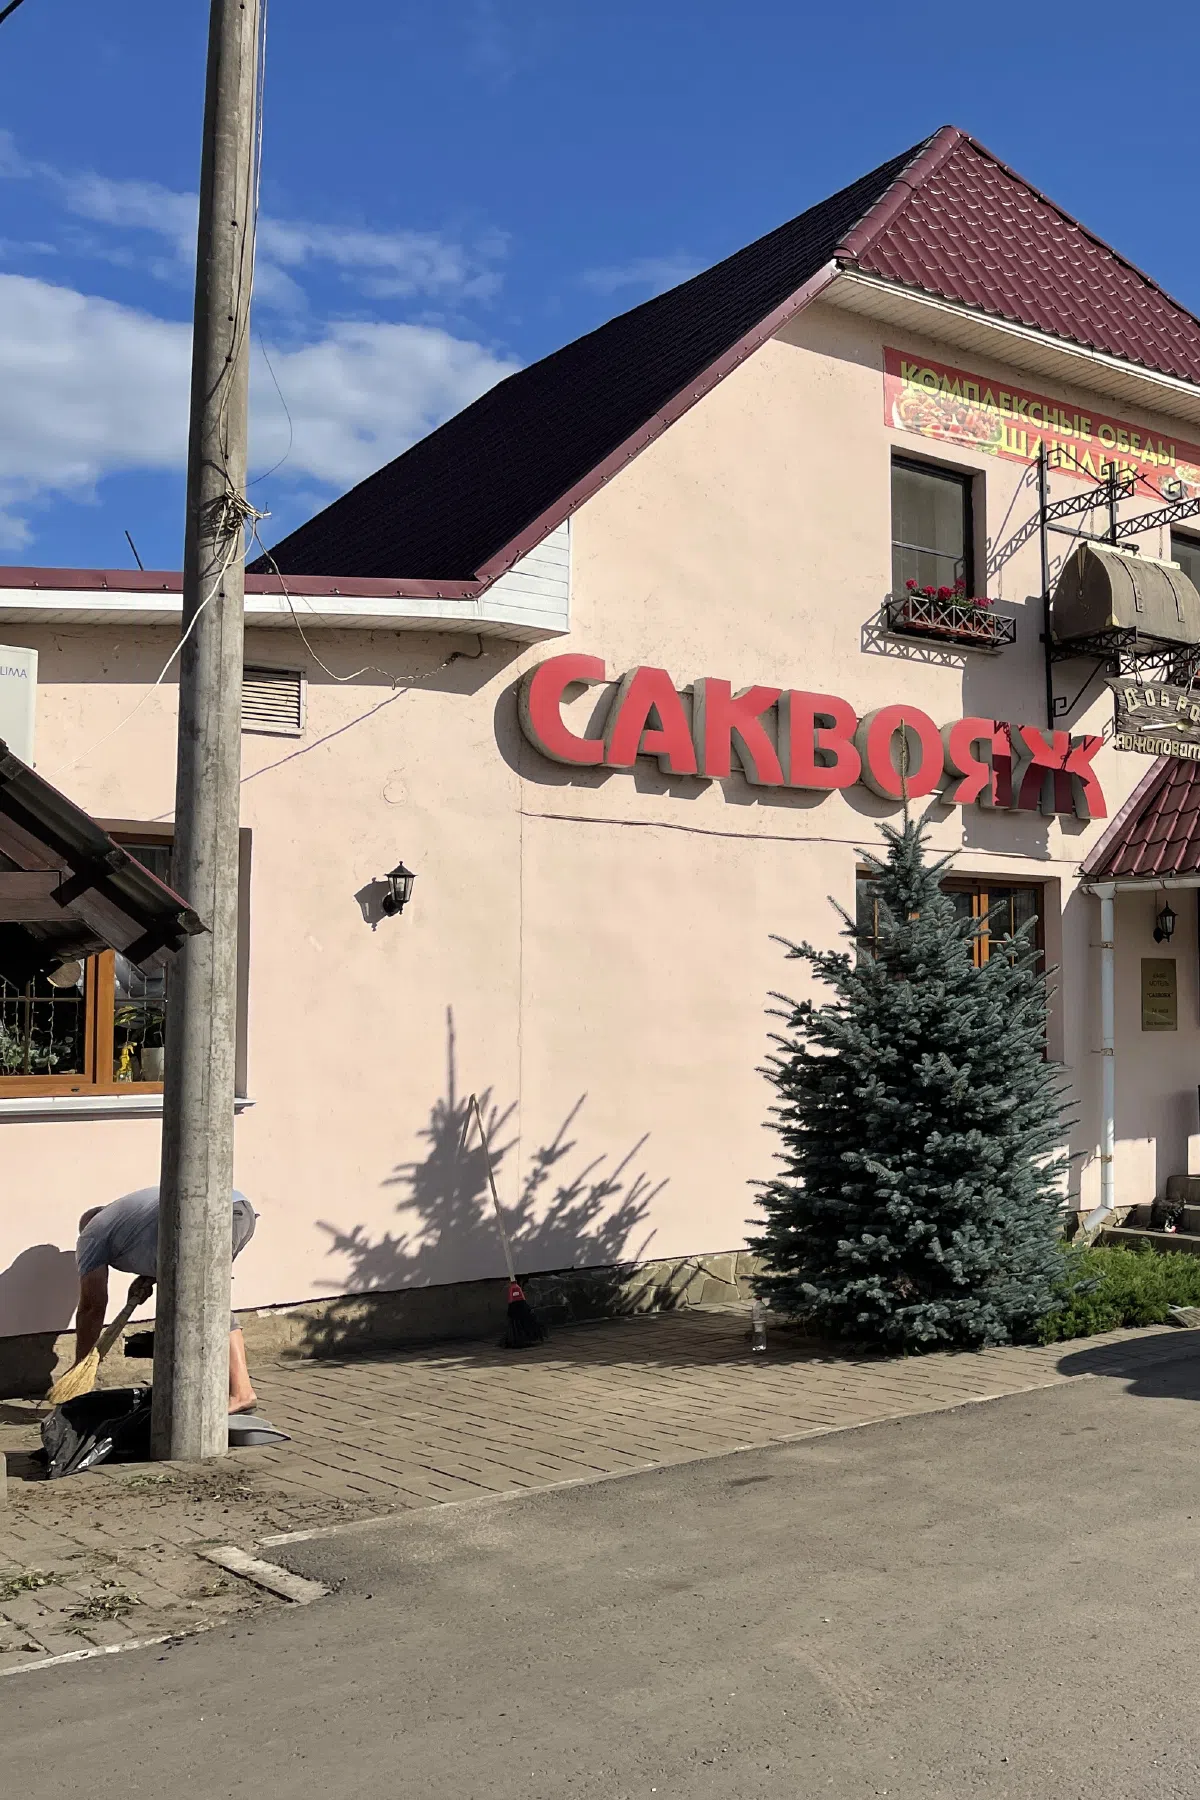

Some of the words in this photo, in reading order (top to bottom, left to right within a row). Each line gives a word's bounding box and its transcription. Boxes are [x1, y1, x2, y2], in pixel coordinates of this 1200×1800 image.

[900, 360, 1093, 443] КОМПЛЕКСНЫЕ
[1098, 423, 1177, 469] ОБЕДЫ
[1000, 423, 1139, 490] ШАШЛЫК
[518, 653, 1109, 819] САКВОЯЖ
